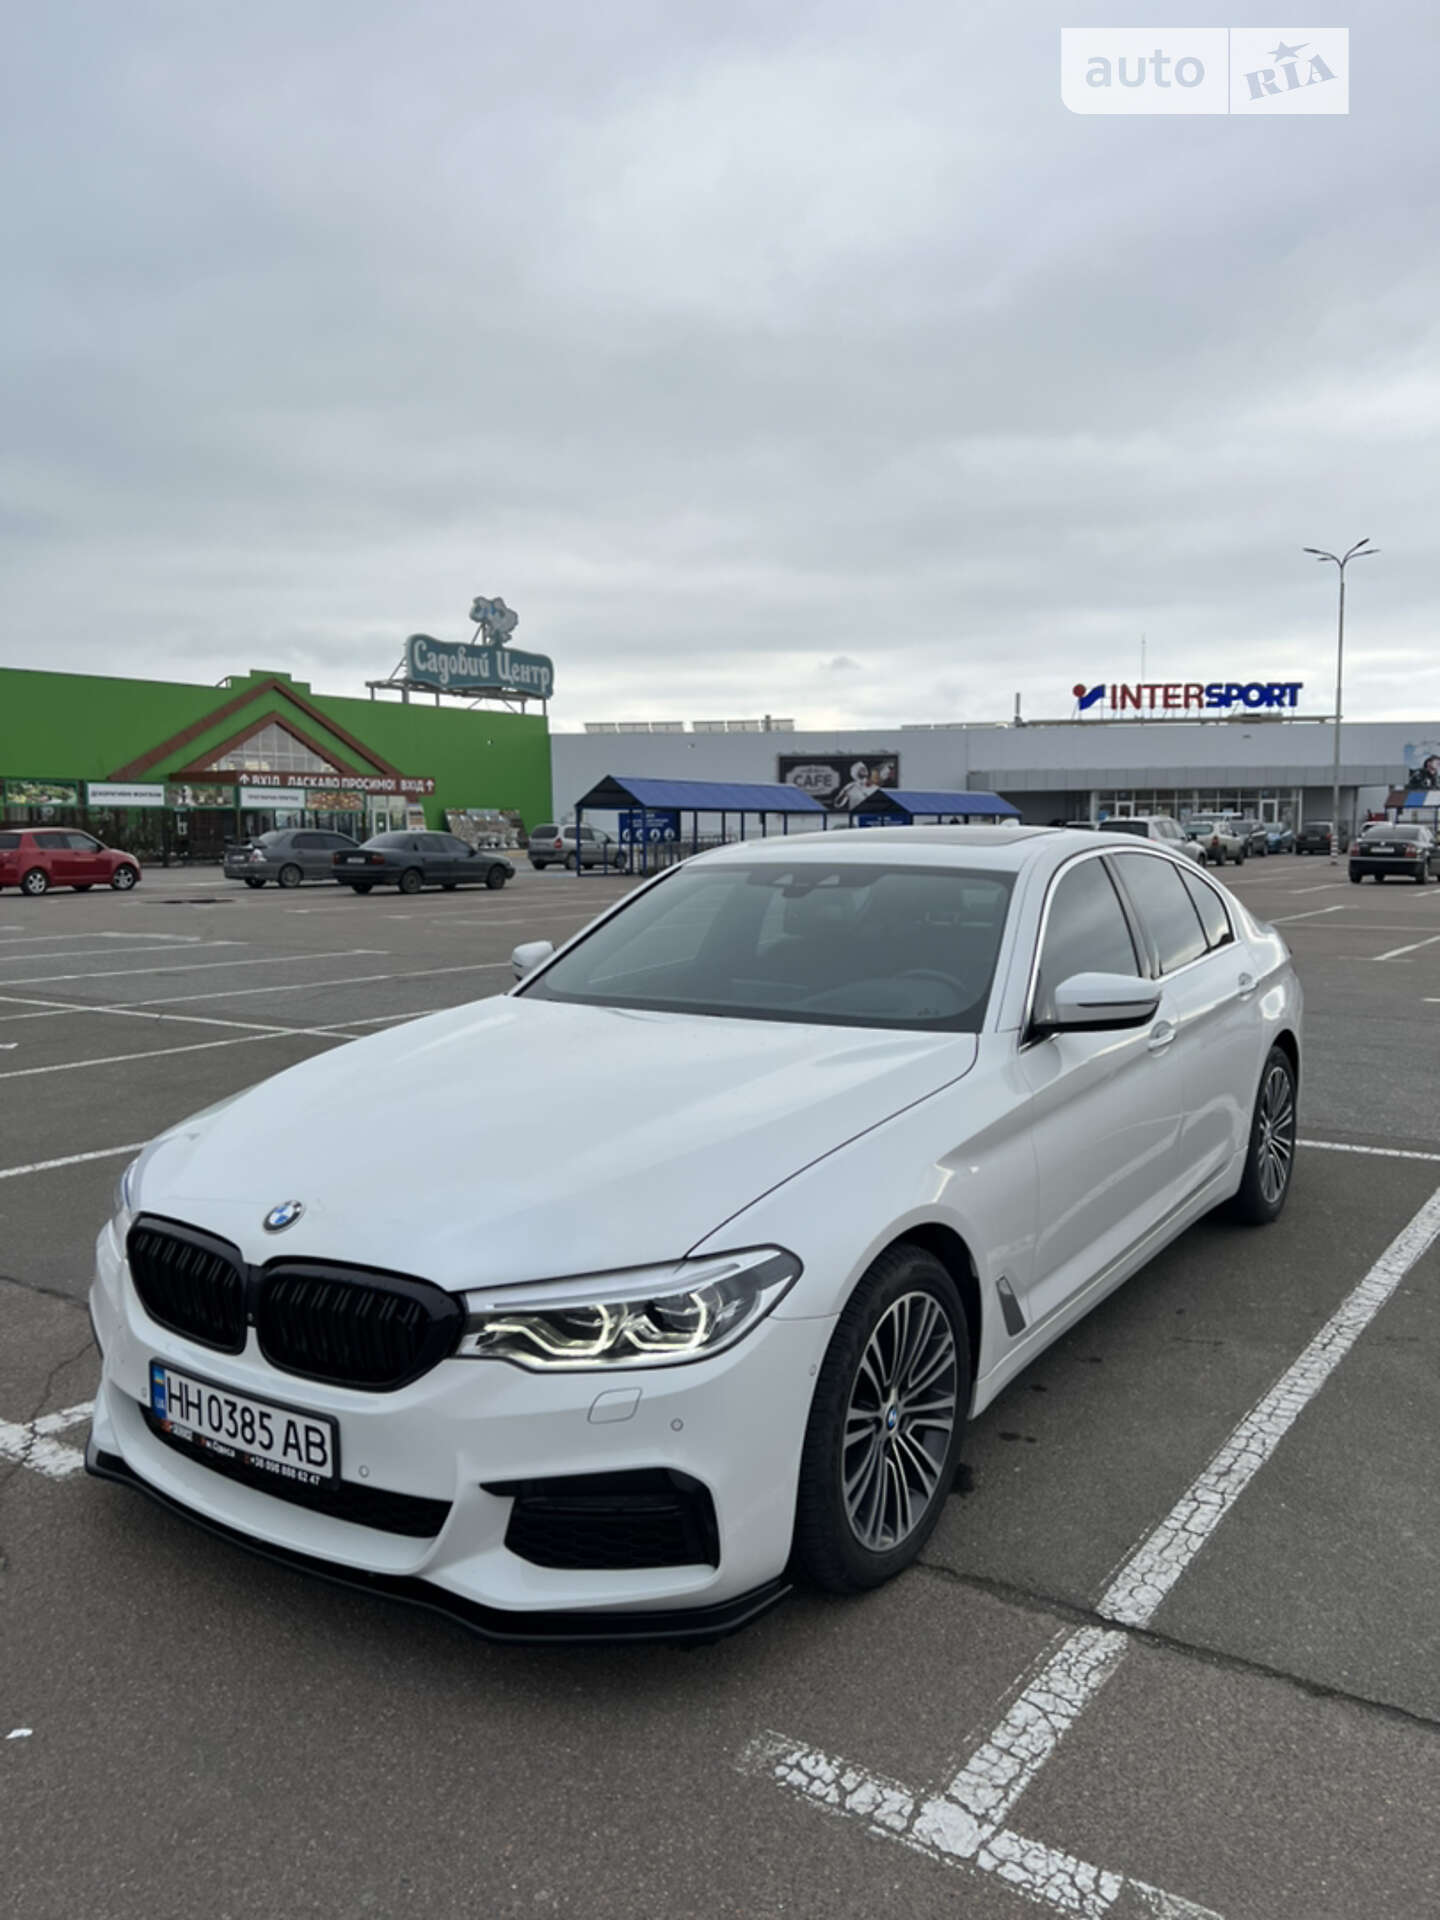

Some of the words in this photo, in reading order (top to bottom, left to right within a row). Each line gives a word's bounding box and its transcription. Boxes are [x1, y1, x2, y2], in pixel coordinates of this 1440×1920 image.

[413, 640, 490, 684] Садовий
[495, 651, 550, 693] Центр
[1111, 683, 1303, 709] INTERSPORT
[287, 776, 340, 788] ЛАСКАВО
[401, 782, 424, 793] ВХІД
[793, 774, 833, 787] CAFE
[282, 1419, 328, 1468] AB
